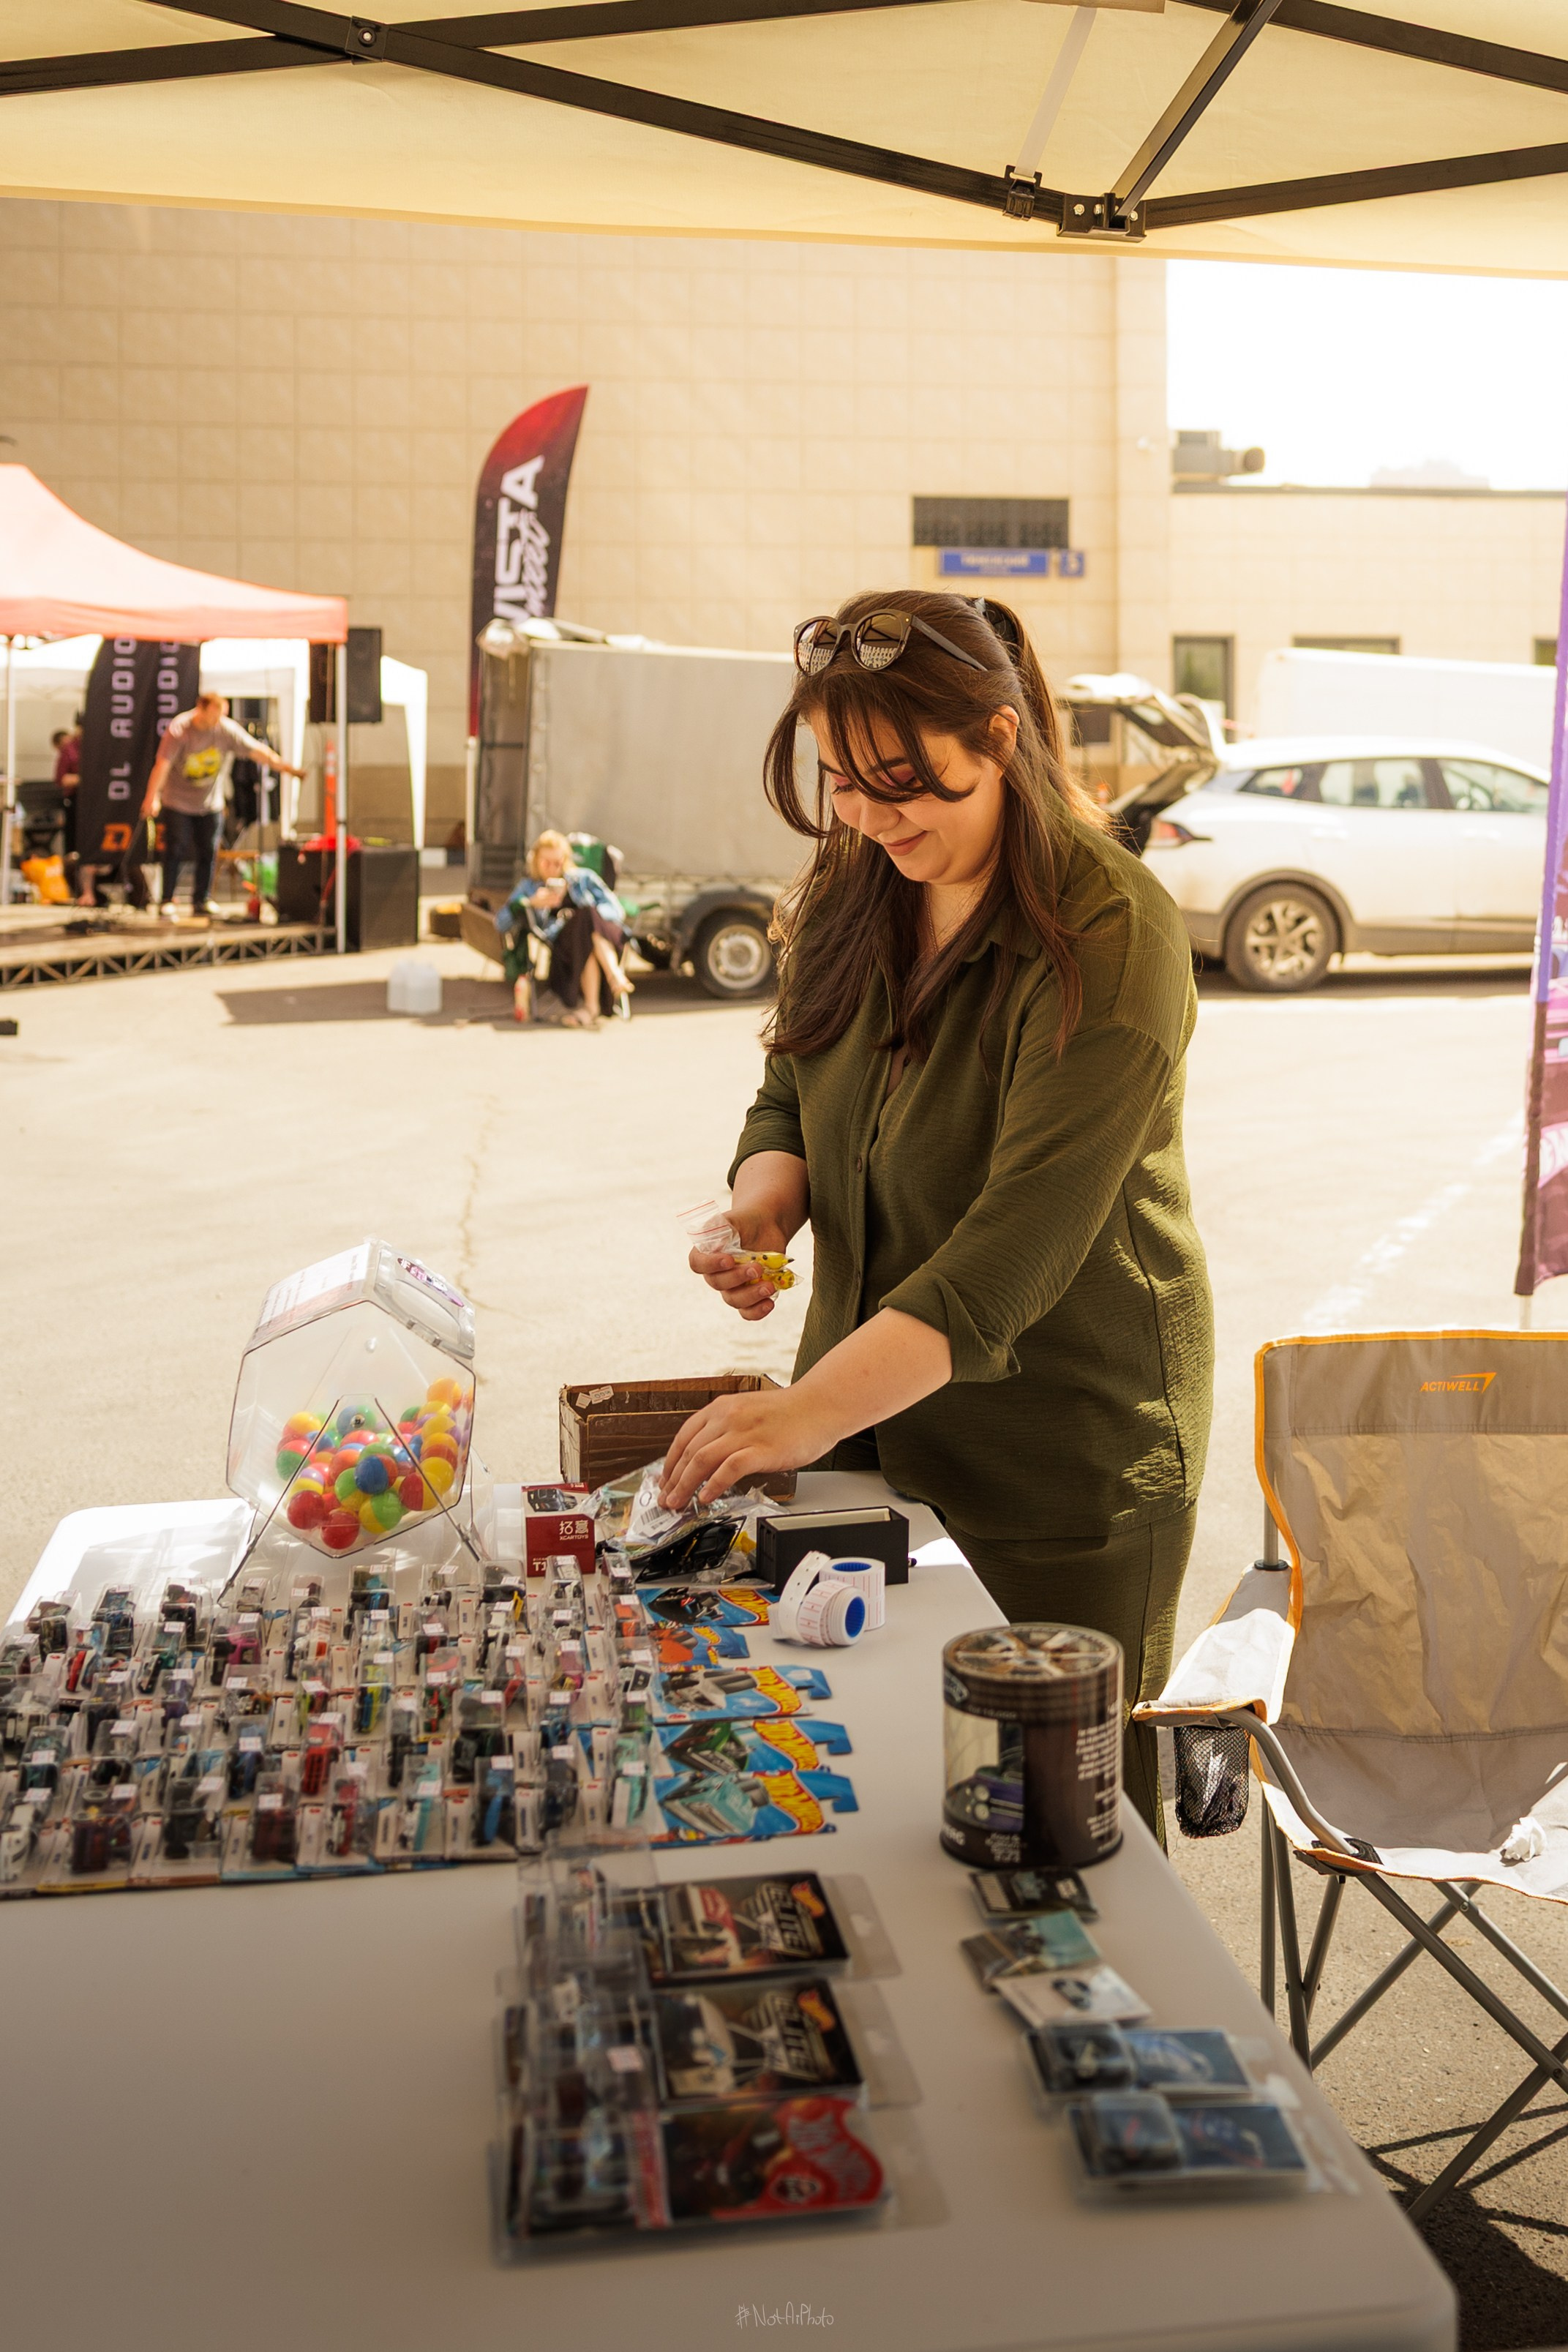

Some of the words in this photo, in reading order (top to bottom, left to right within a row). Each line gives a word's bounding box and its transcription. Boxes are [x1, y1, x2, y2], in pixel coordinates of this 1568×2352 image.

[493, 454, 546, 623] VISTA
[110, 637, 137, 739] AUDIO
[108, 761, 131, 801] DL
[1420, 1381, 1479, 1392] ACTIWELL
